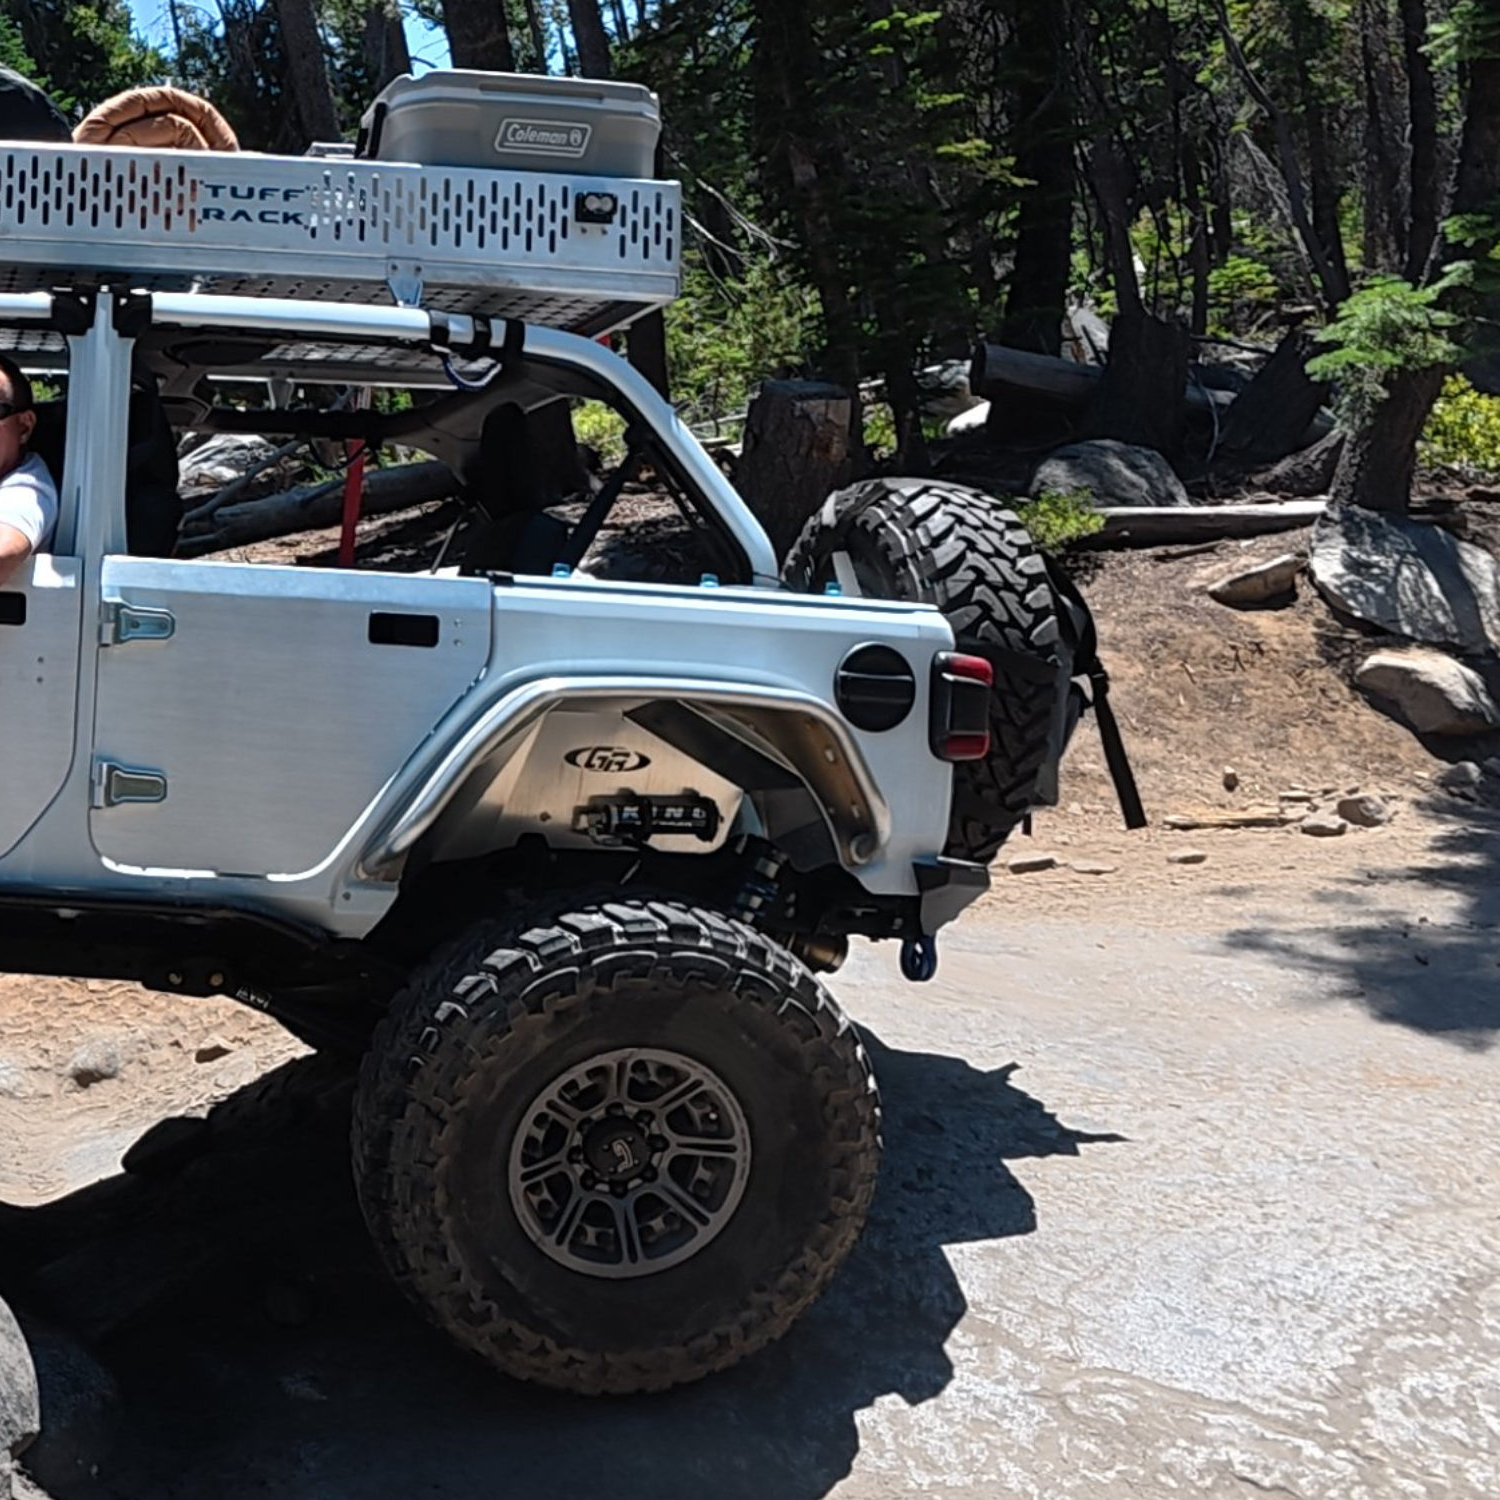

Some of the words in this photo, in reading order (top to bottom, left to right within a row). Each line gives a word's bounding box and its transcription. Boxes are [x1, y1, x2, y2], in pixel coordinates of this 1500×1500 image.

[506, 123, 568, 144] Coleman
[204, 183, 305, 202] TUFF
[201, 207, 305, 226] RACK
